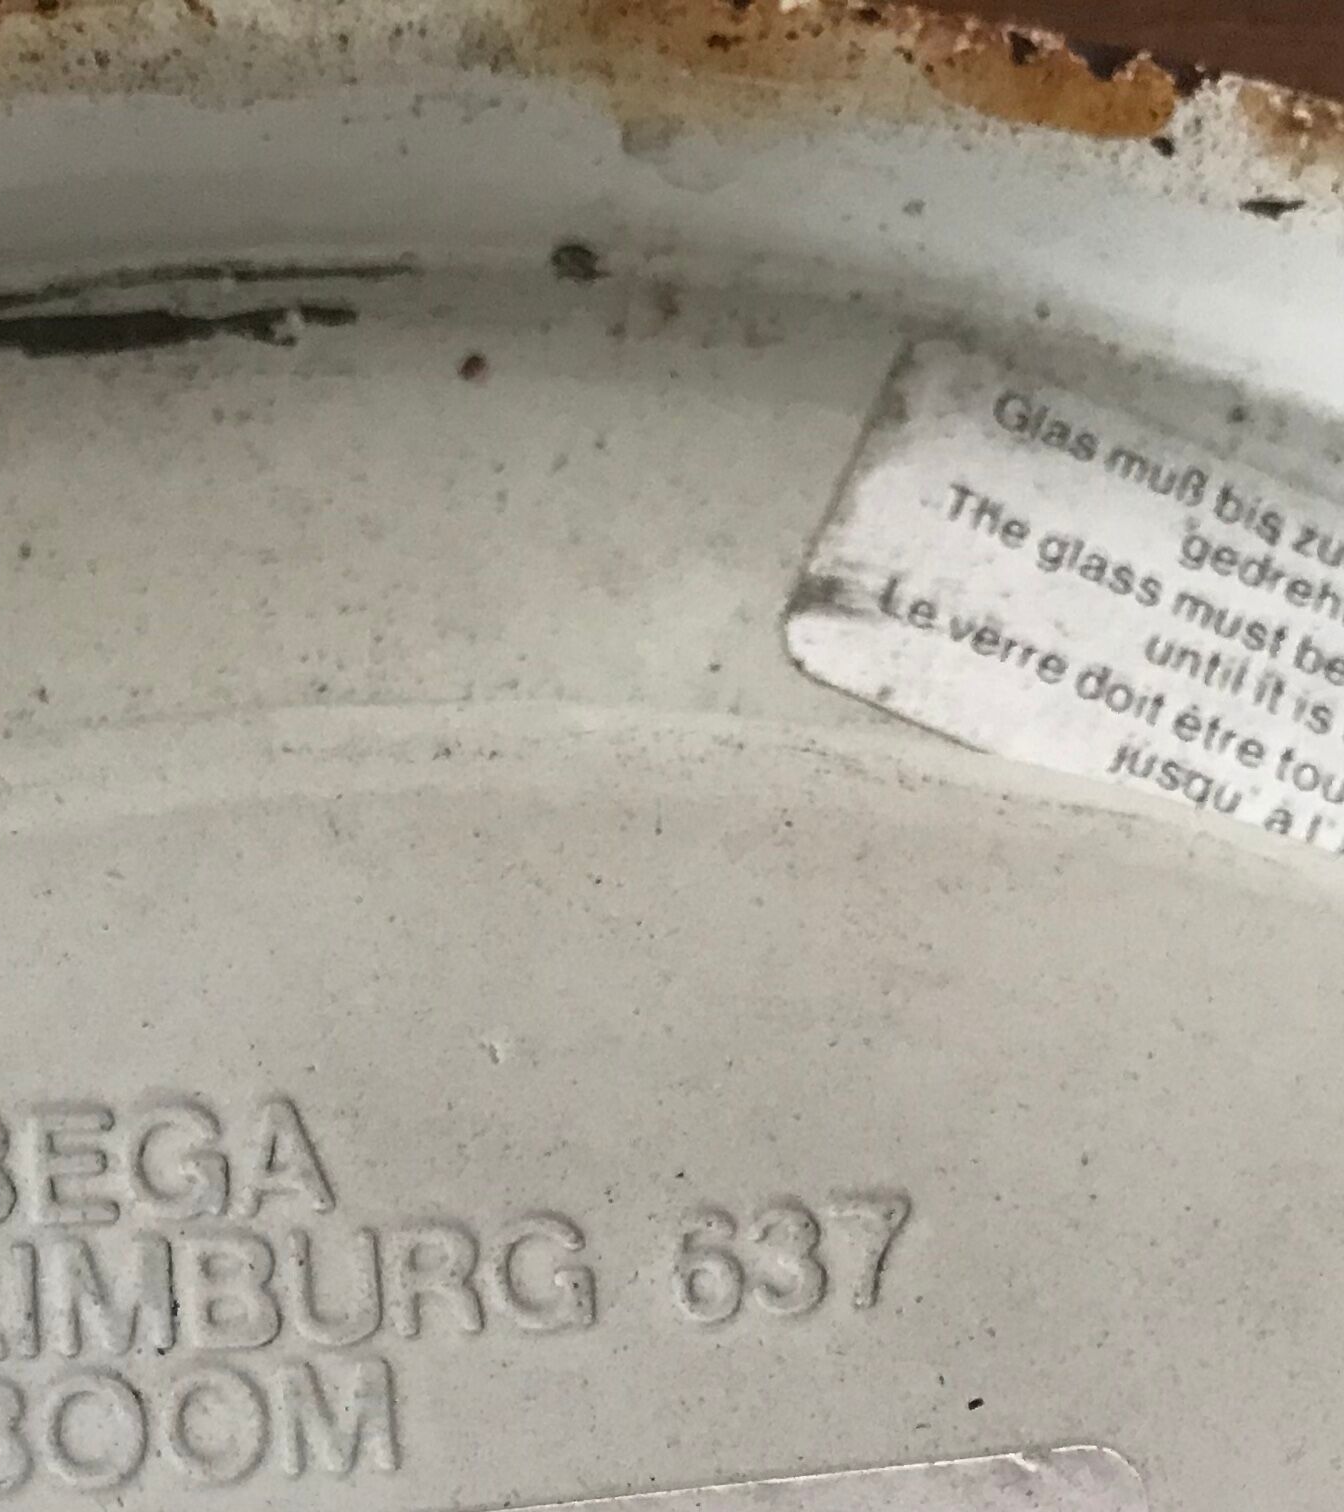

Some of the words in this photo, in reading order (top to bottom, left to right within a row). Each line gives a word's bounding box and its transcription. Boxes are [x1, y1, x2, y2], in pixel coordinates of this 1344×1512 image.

[992, 391, 1099, 462] Glas
[1104, 446, 1209, 507] muß
[1213, 481, 1286, 546] bis
[949, 482, 1031, 550] The
[1036, 532, 1163, 608] glass
[1172, 590, 1290, 658] must
[878, 574, 937, 630] Le
[949, 613, 1069, 684] verre
[1075, 664, 1165, 727] doit
[1144, 634, 1249, 696] until
[1254, 668, 1286, 715] it
[1292, 688, 1334, 735] is
[668, 1194, 911, 1331] 637
